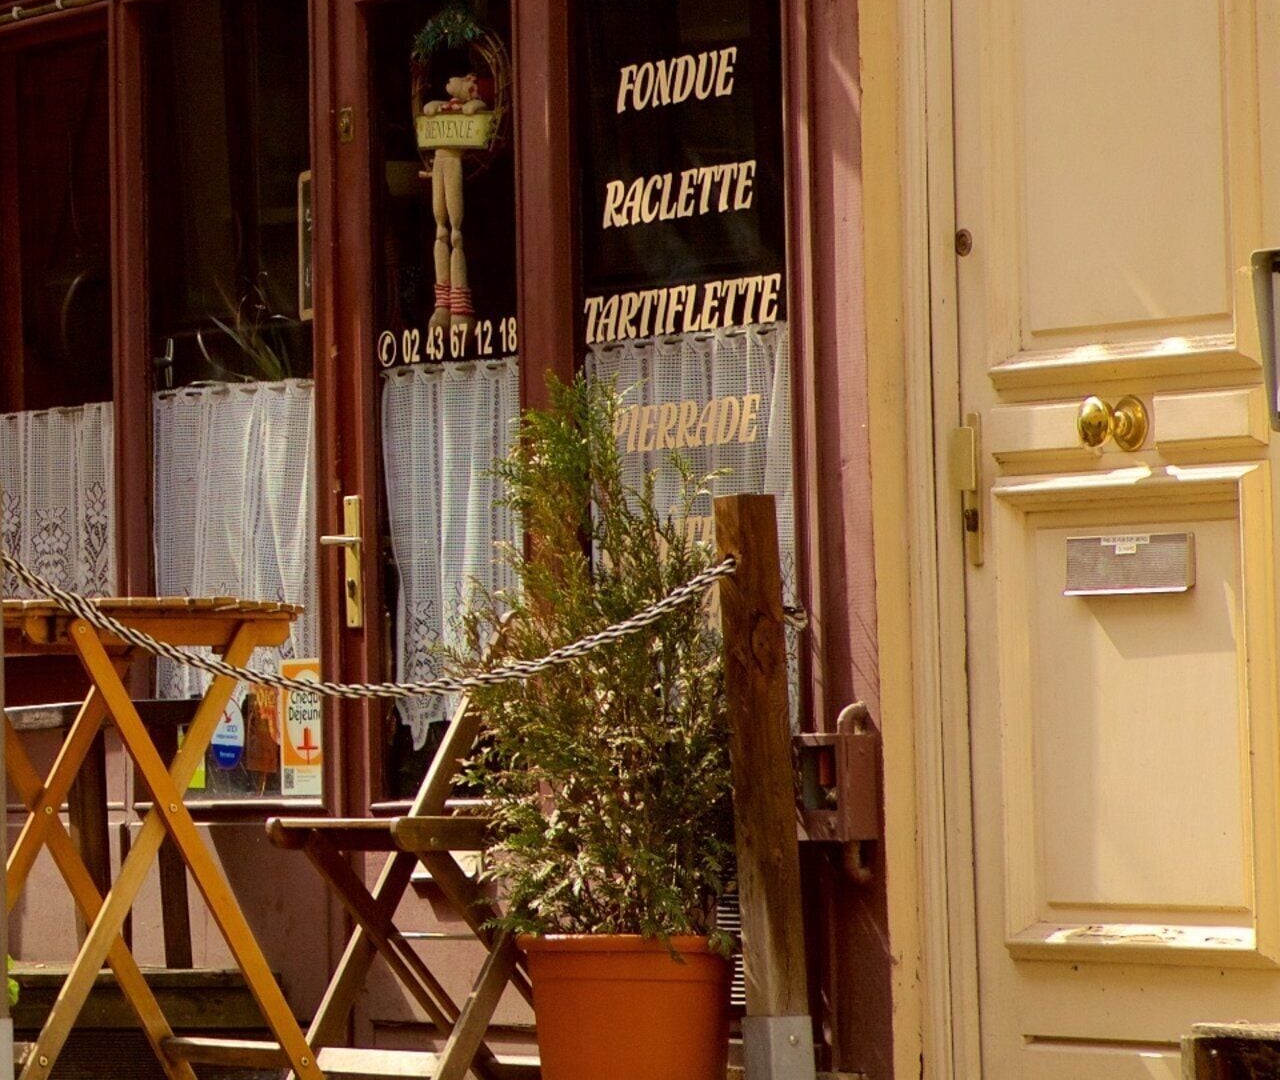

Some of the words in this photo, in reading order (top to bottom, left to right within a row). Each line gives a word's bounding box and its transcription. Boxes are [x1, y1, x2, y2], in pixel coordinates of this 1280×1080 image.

[617, 47, 737, 114] FONDUE
[603, 160, 756, 229] RACLETTE
[402, 329, 421, 364] 02
[426, 327, 445, 361] 43
[450, 324, 467, 358] 67
[475, 320, 493, 355] 12
[500, 317, 518, 353] 18
[584, 273, 782, 344] TARTIFLETTE
[288, 705, 320, 725] Déjeun
